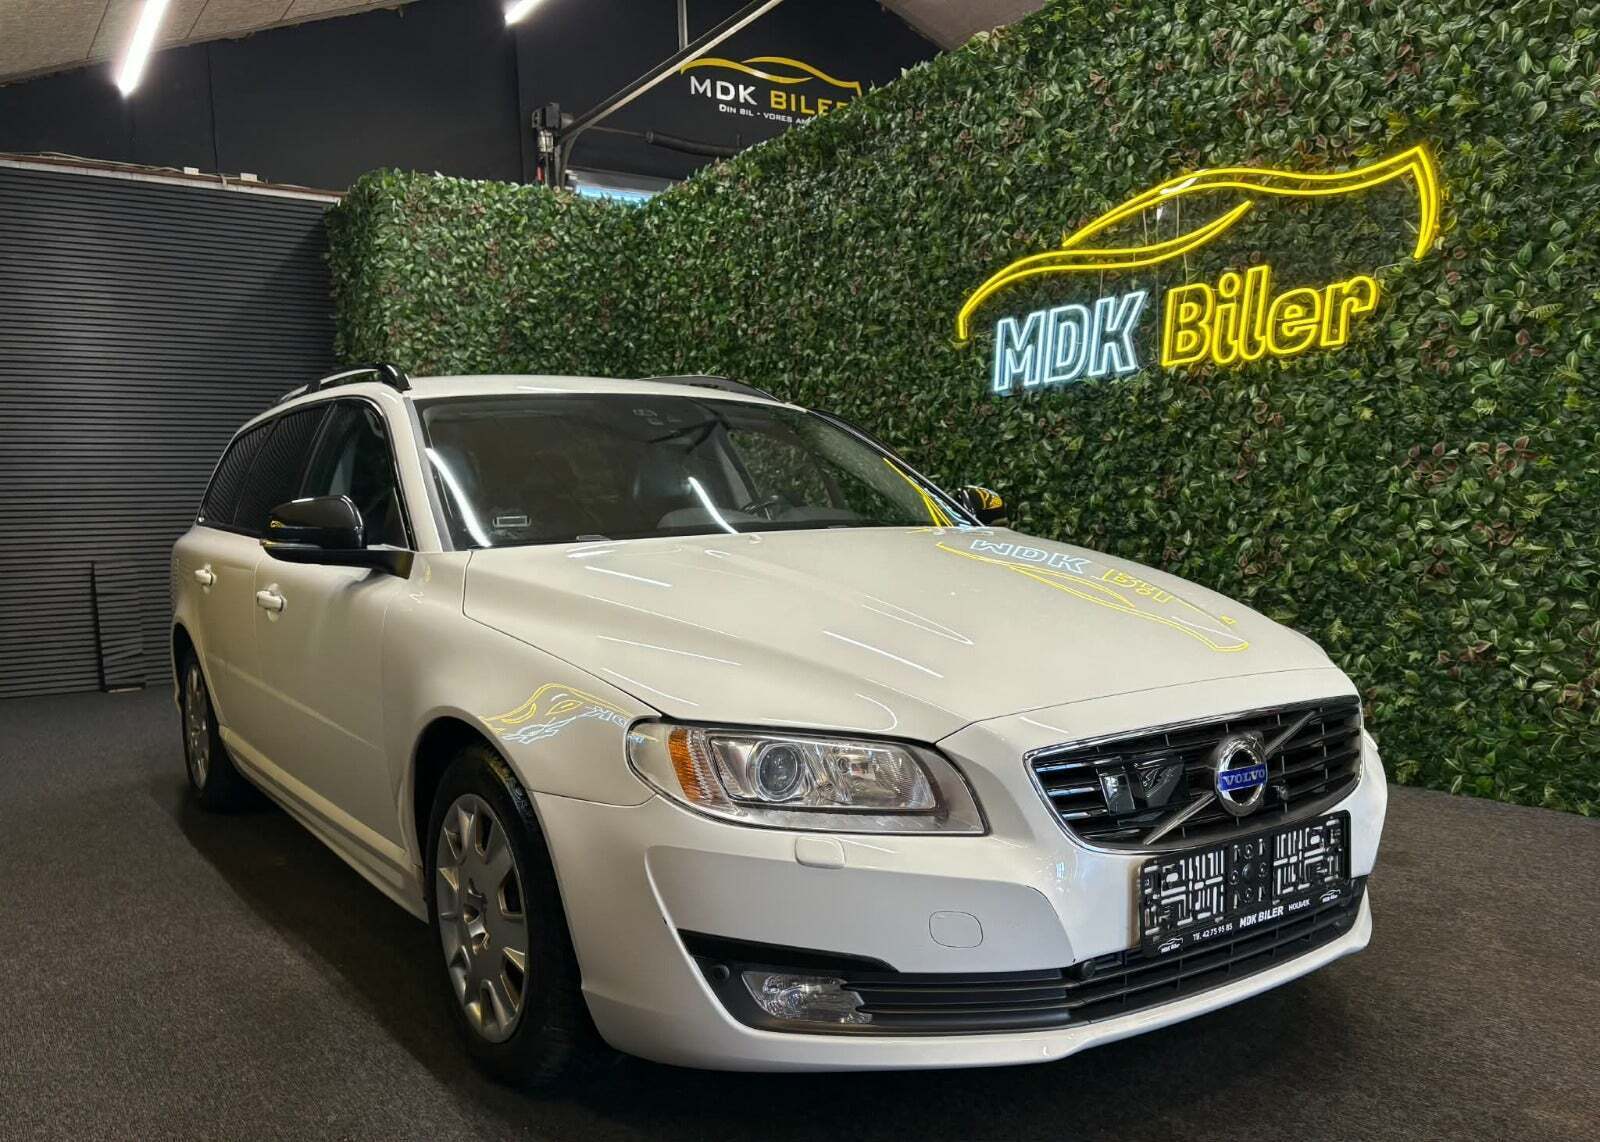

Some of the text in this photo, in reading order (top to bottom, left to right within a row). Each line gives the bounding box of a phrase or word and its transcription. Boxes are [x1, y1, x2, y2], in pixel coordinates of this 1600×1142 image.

[690, 75, 758, 106] MDK
[763, 112, 793, 123] VORES
[993, 264, 1379, 393] MDK Biler
[1222, 768, 1265, 786] VOLVO
[1210, 927, 1218, 936] 75
[1217, 925, 1225, 934] 95
[1240, 913, 1257, 929] MDK
[1257, 905, 1284, 923] BILER
